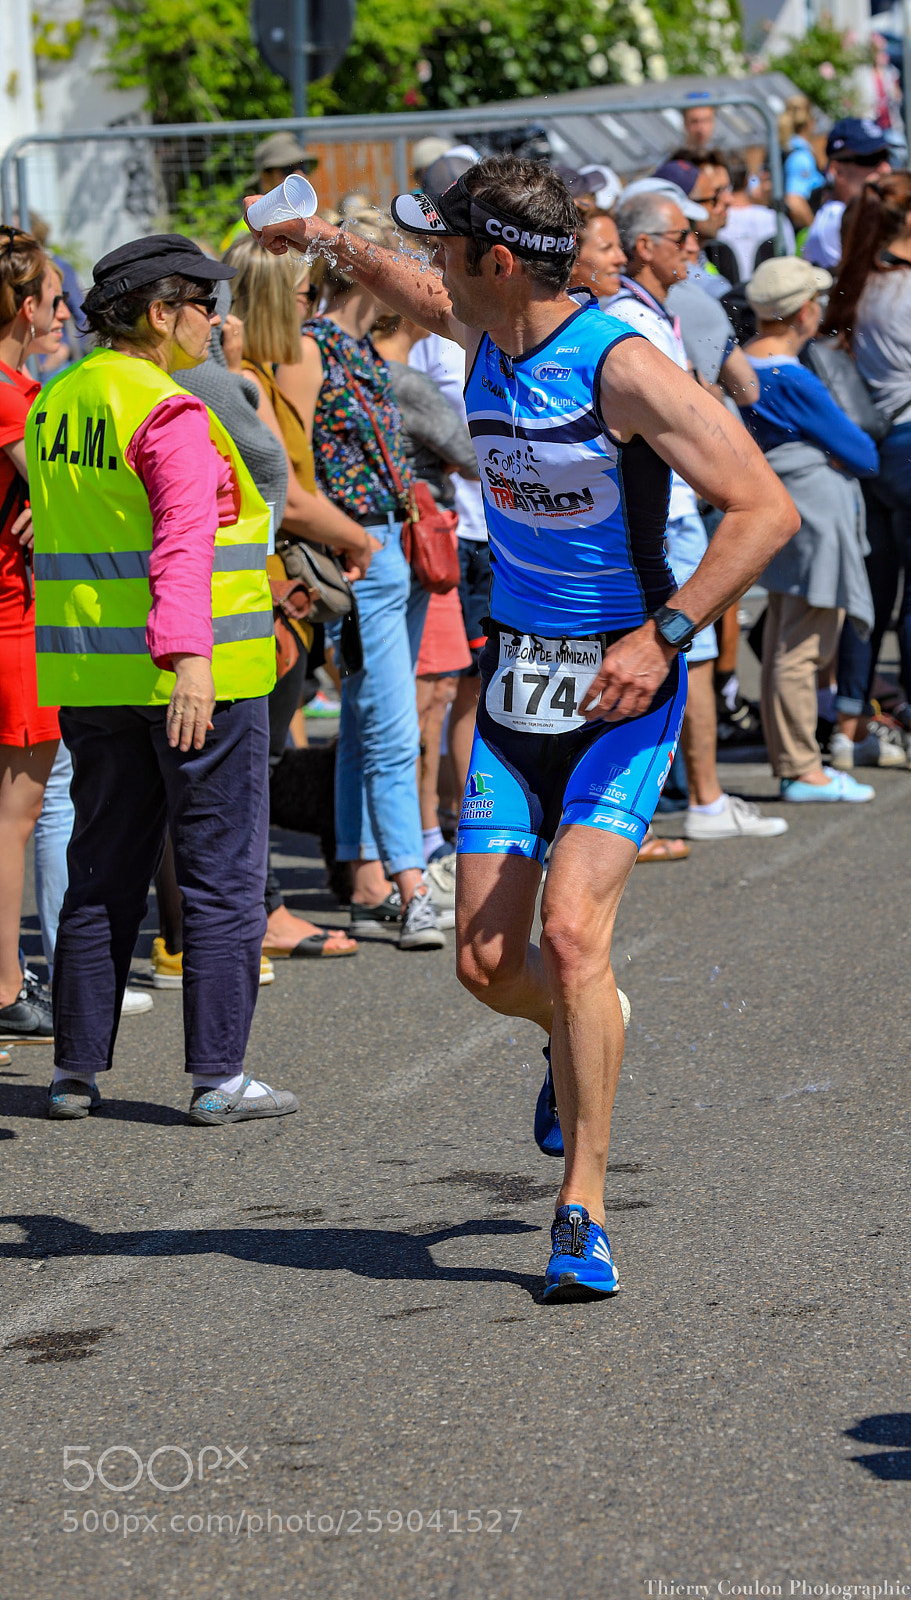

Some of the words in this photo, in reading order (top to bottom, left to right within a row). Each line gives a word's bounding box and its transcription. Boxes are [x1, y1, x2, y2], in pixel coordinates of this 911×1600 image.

[555, 346, 580, 355] poli
[550, 396, 577, 408] Dupré
[539, 649, 553, 663] DE
[500, 670, 578, 718] 174
[588, 783, 628, 801] saintes
[592, 814, 639, 833] poli
[487, 839, 531, 849] poli
